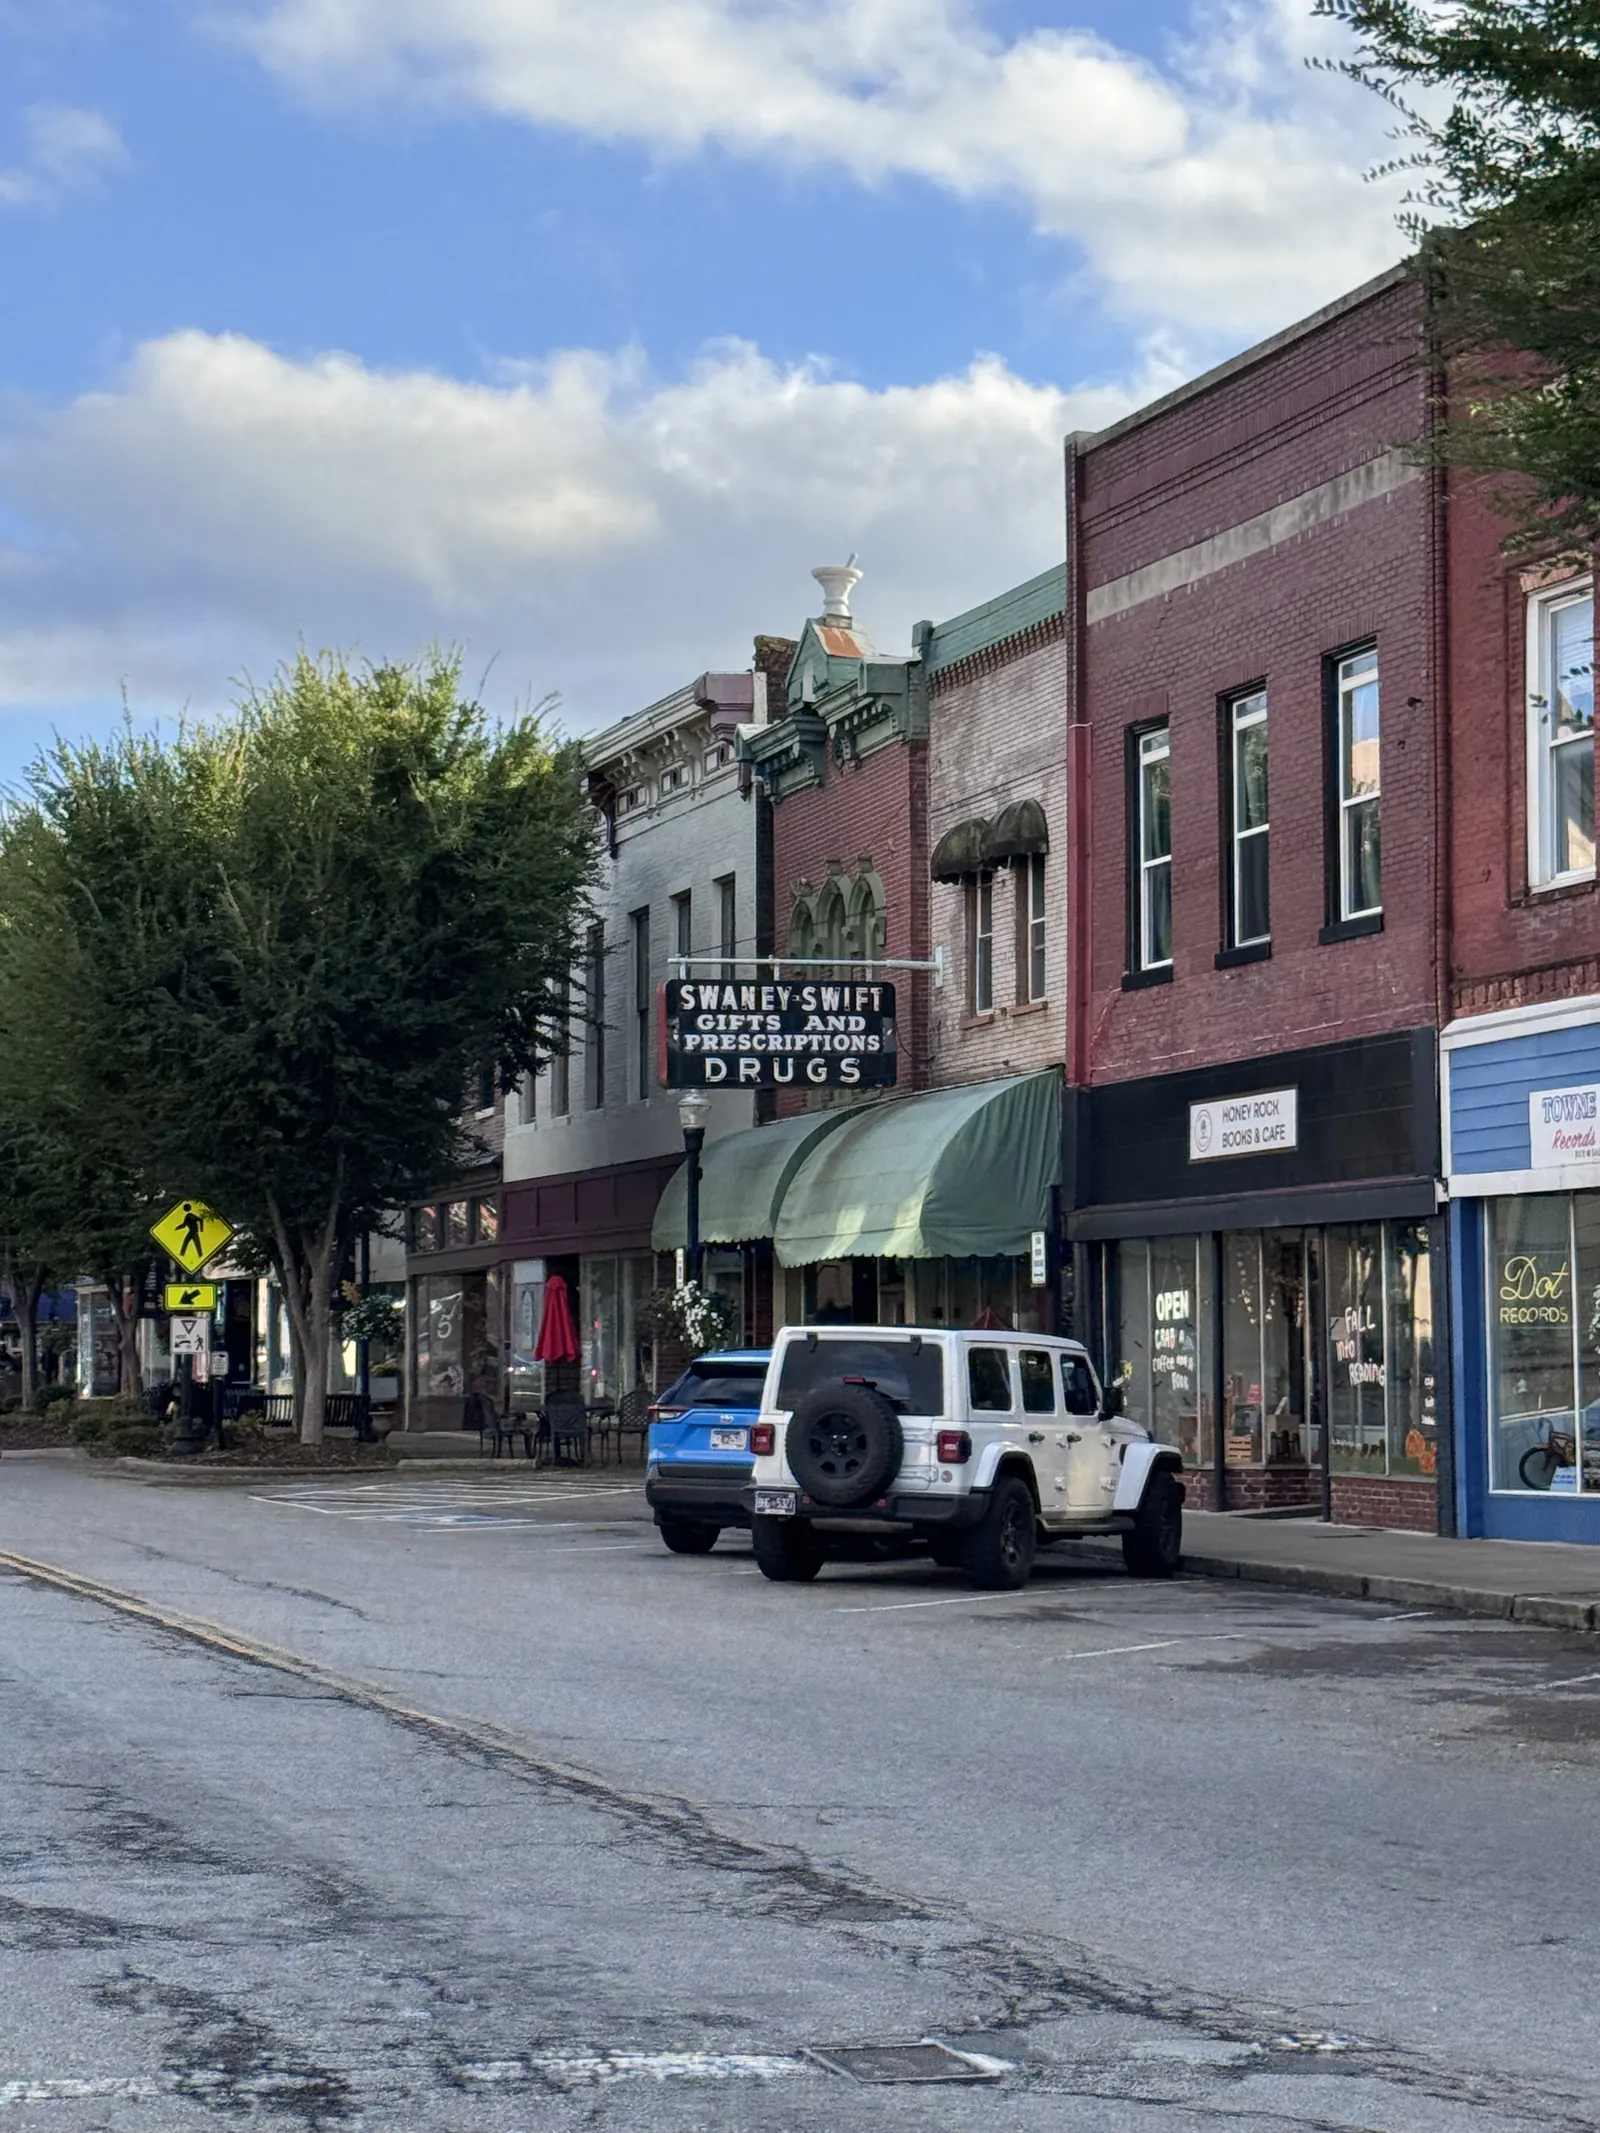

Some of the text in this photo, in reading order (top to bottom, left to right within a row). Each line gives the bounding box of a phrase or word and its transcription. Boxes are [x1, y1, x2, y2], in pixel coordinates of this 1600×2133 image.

[696, 1014, 866, 1032] GIFTS AND
[684, 1033, 881, 1052] PRESCRIPTIONS
[705, 1057, 861, 1083] DRUGS
[1221, 1099, 1280, 1124] HONEY ROCK
[1541, 1091, 1597, 1124] TOWNE
[1221, 1123, 1286, 1149] BOOKS & CAFE
[1552, 1126, 1596, 1150] Records
[1500, 1256, 1569, 1300] Dot
[1155, 1289, 1189, 1321] OPEN
[1500, 1306, 1569, 1324] RECORDS
[1344, 1304, 1376, 1334] FALL
